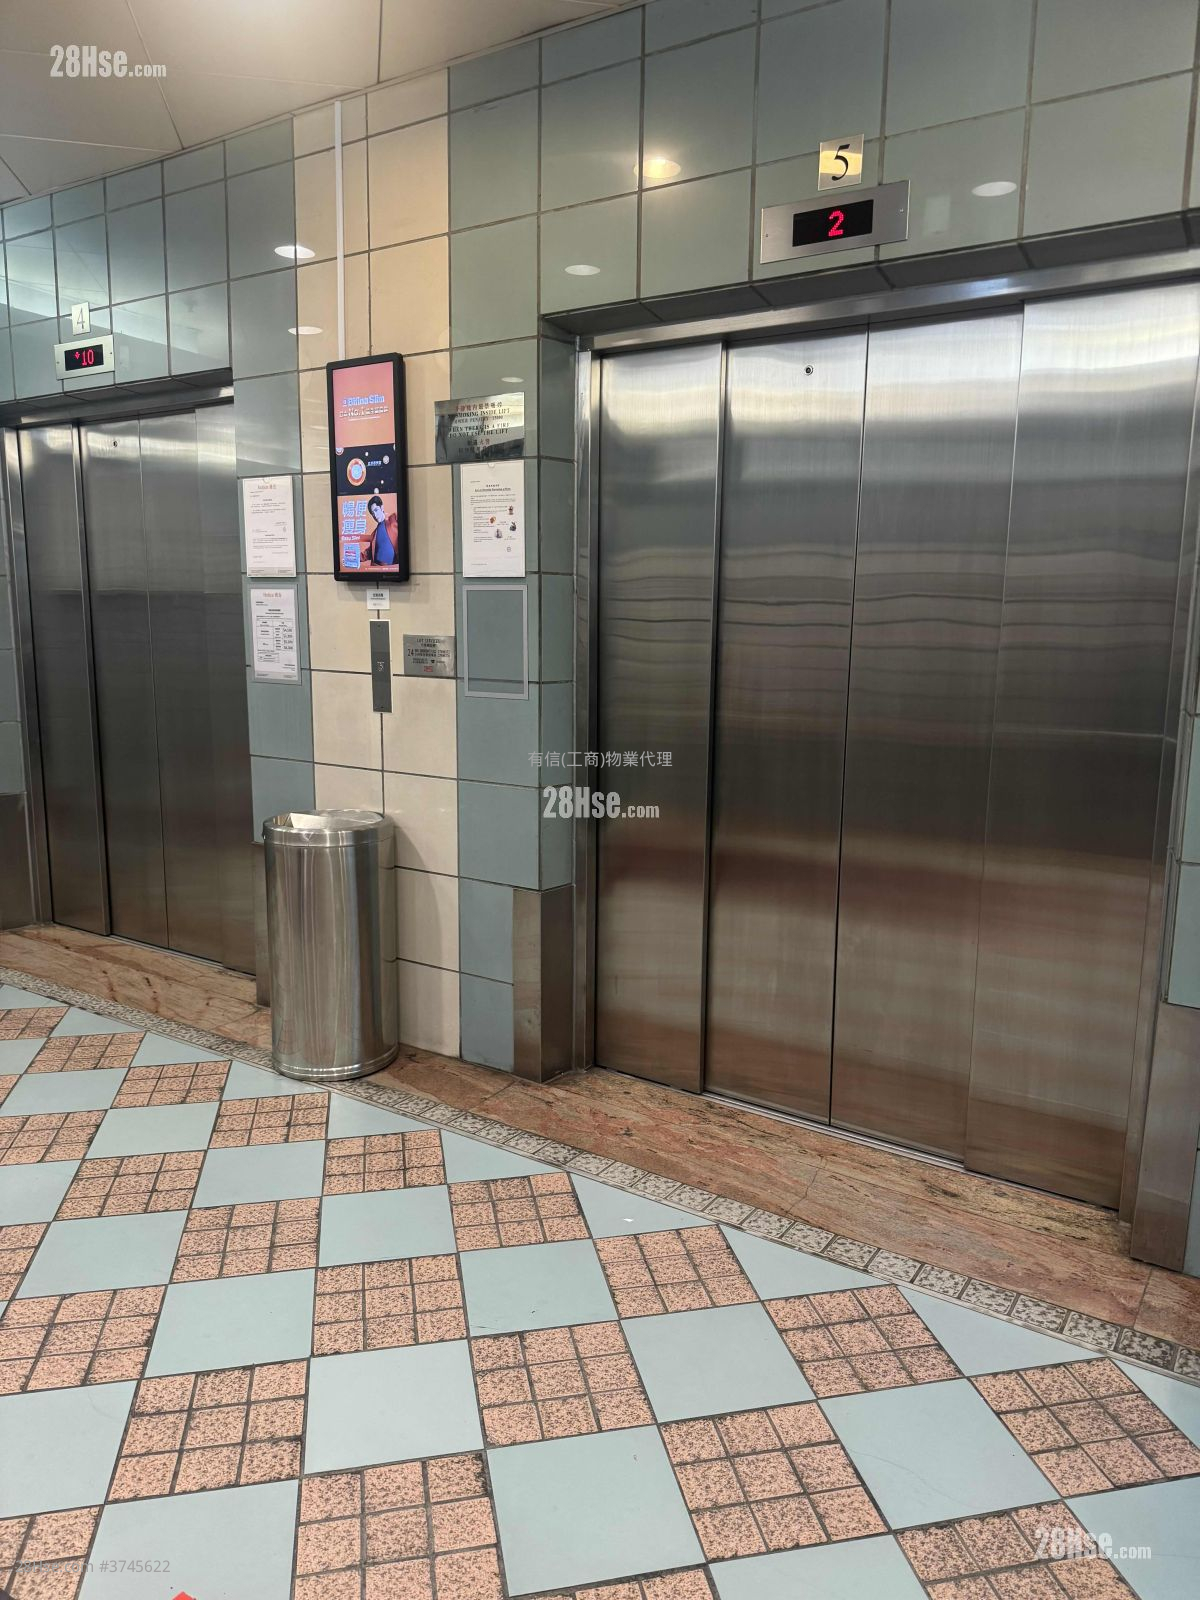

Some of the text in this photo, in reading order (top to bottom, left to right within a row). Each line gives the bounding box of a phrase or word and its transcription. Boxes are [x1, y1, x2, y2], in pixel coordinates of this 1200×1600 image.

[832, 144, 850, 181] 5
[828, 210, 845, 237] 2
[77, 307, 86, 330] 4
[82, 349, 94, 366] 10
